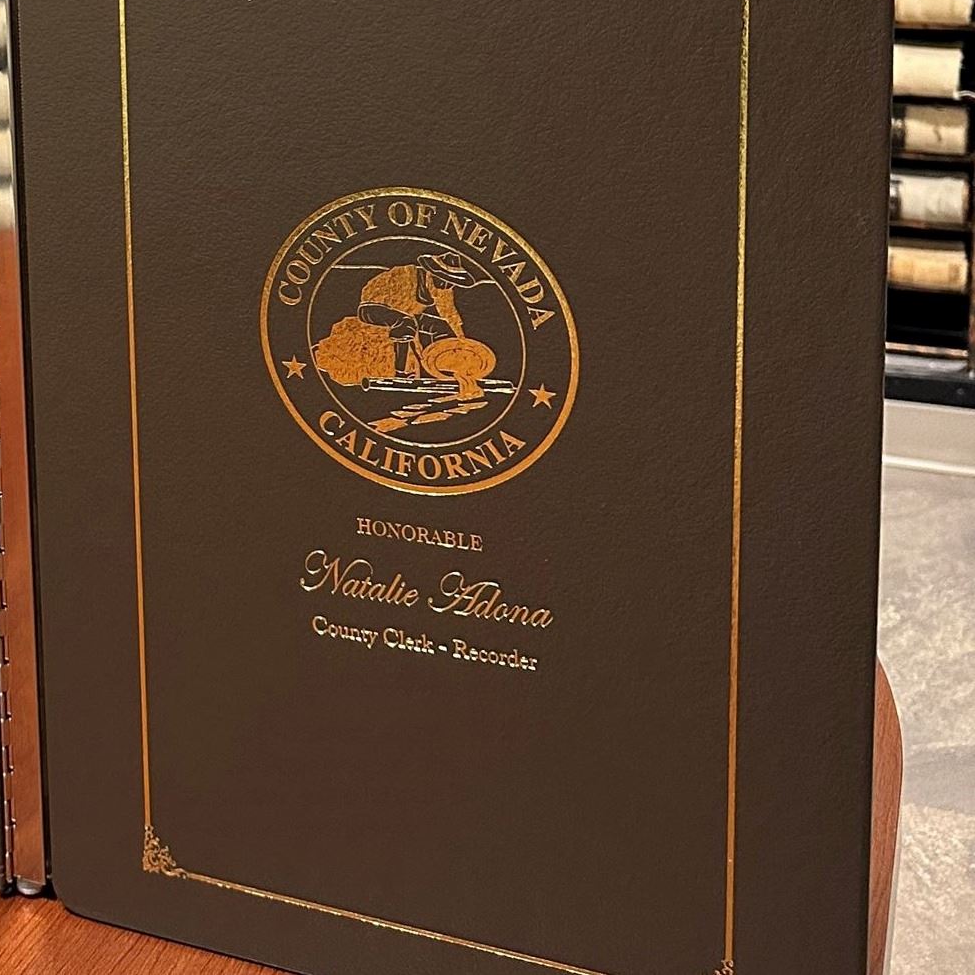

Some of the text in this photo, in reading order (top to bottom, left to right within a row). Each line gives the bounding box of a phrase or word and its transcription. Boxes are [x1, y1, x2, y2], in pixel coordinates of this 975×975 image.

[278, 201, 556, 330] COUNTY OF NEVADA
[319, 410, 527, 481] CALIFORNIA
[356, 517, 484, 553] HONORABLE
[299, 550, 555, 629] Natalie Adona
[312, 615, 379, 650] County
[383, 627, 435, 655] Clerk
[452, 638, 538, 671] Recorder
